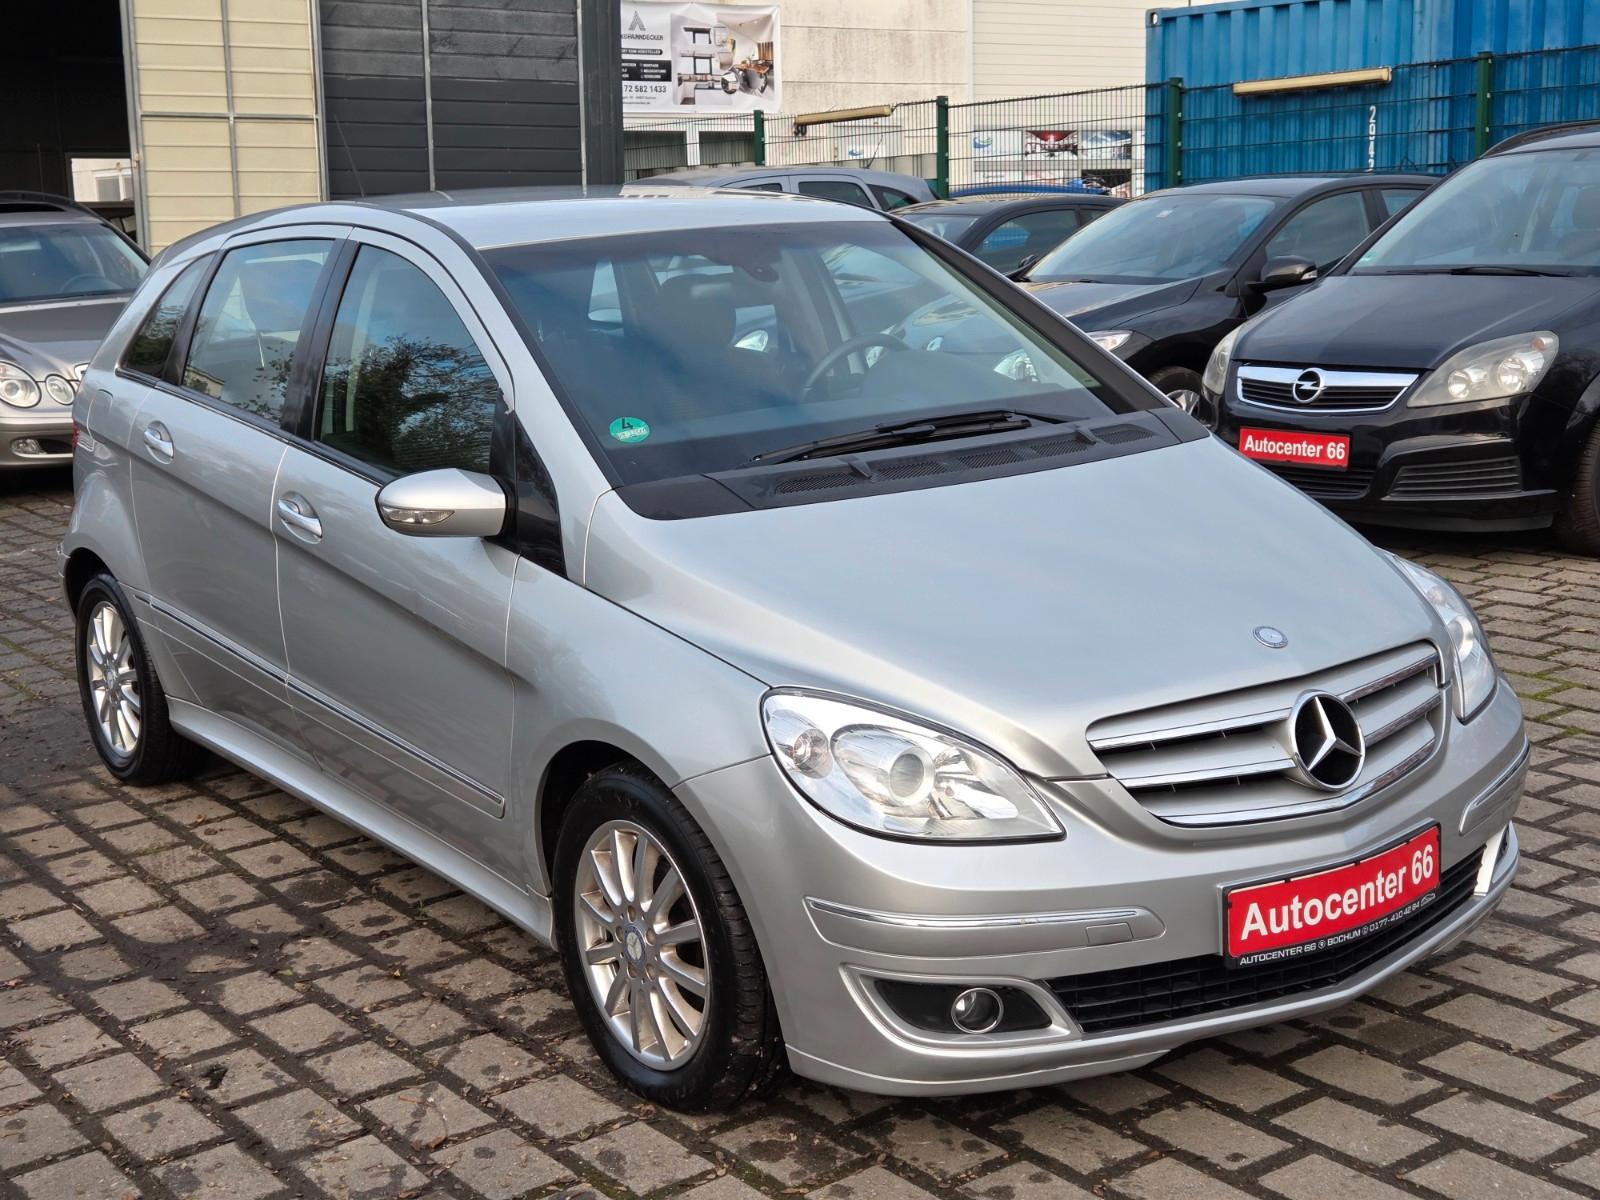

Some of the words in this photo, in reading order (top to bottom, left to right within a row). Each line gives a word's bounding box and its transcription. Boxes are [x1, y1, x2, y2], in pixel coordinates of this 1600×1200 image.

[634, 85, 648, 93] 582
[650, 85, 667, 93] 1433
[1244, 434, 1323, 458] Autocenter
[1326, 442, 1345, 460] 66
[1240, 865, 1407, 941] Autocenter
[1411, 844, 1434, 885] 66
[1239, 946, 1302, 966] AUTOCENTER
[1304, 942, 1317, 952] 66
[1327, 929, 1361, 946] BOCHUM
